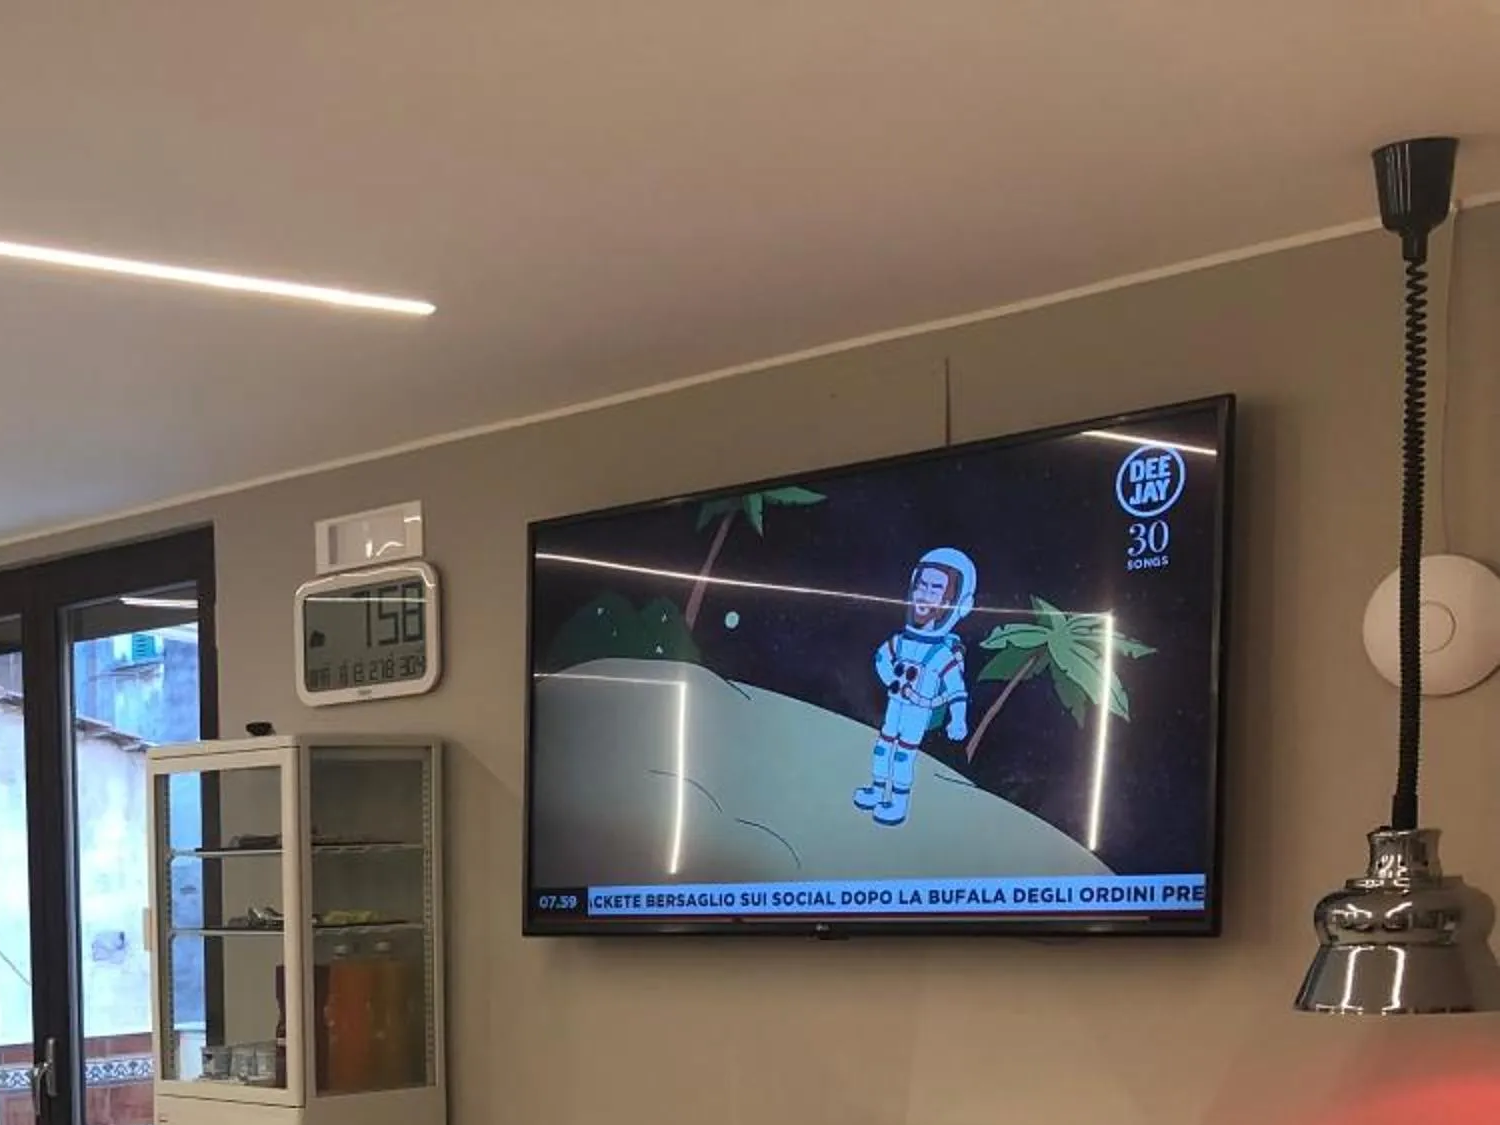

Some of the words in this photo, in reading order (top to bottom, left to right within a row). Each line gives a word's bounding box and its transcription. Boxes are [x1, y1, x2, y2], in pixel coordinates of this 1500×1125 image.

[1130, 455, 1172, 483] DEE
[1129, 478, 1171, 505] JAY
[1127, 520, 1169, 557] 30
[1127, 555, 1169, 571] SONGS
[645, 892, 736, 909] BERSAGLIO
[740, 891, 768, 907] SUI
[772, 890, 837, 907] SOCIAL
[841, 889, 893, 906] DOPO
[898, 889, 923, 905] LA
[928, 887, 1006, 905] BUFALA
[1012, 886, 1073, 904] DEGLI
[1079, 885, 1156, 904] ORDINI
[1162, 884, 1205, 903] PRE
